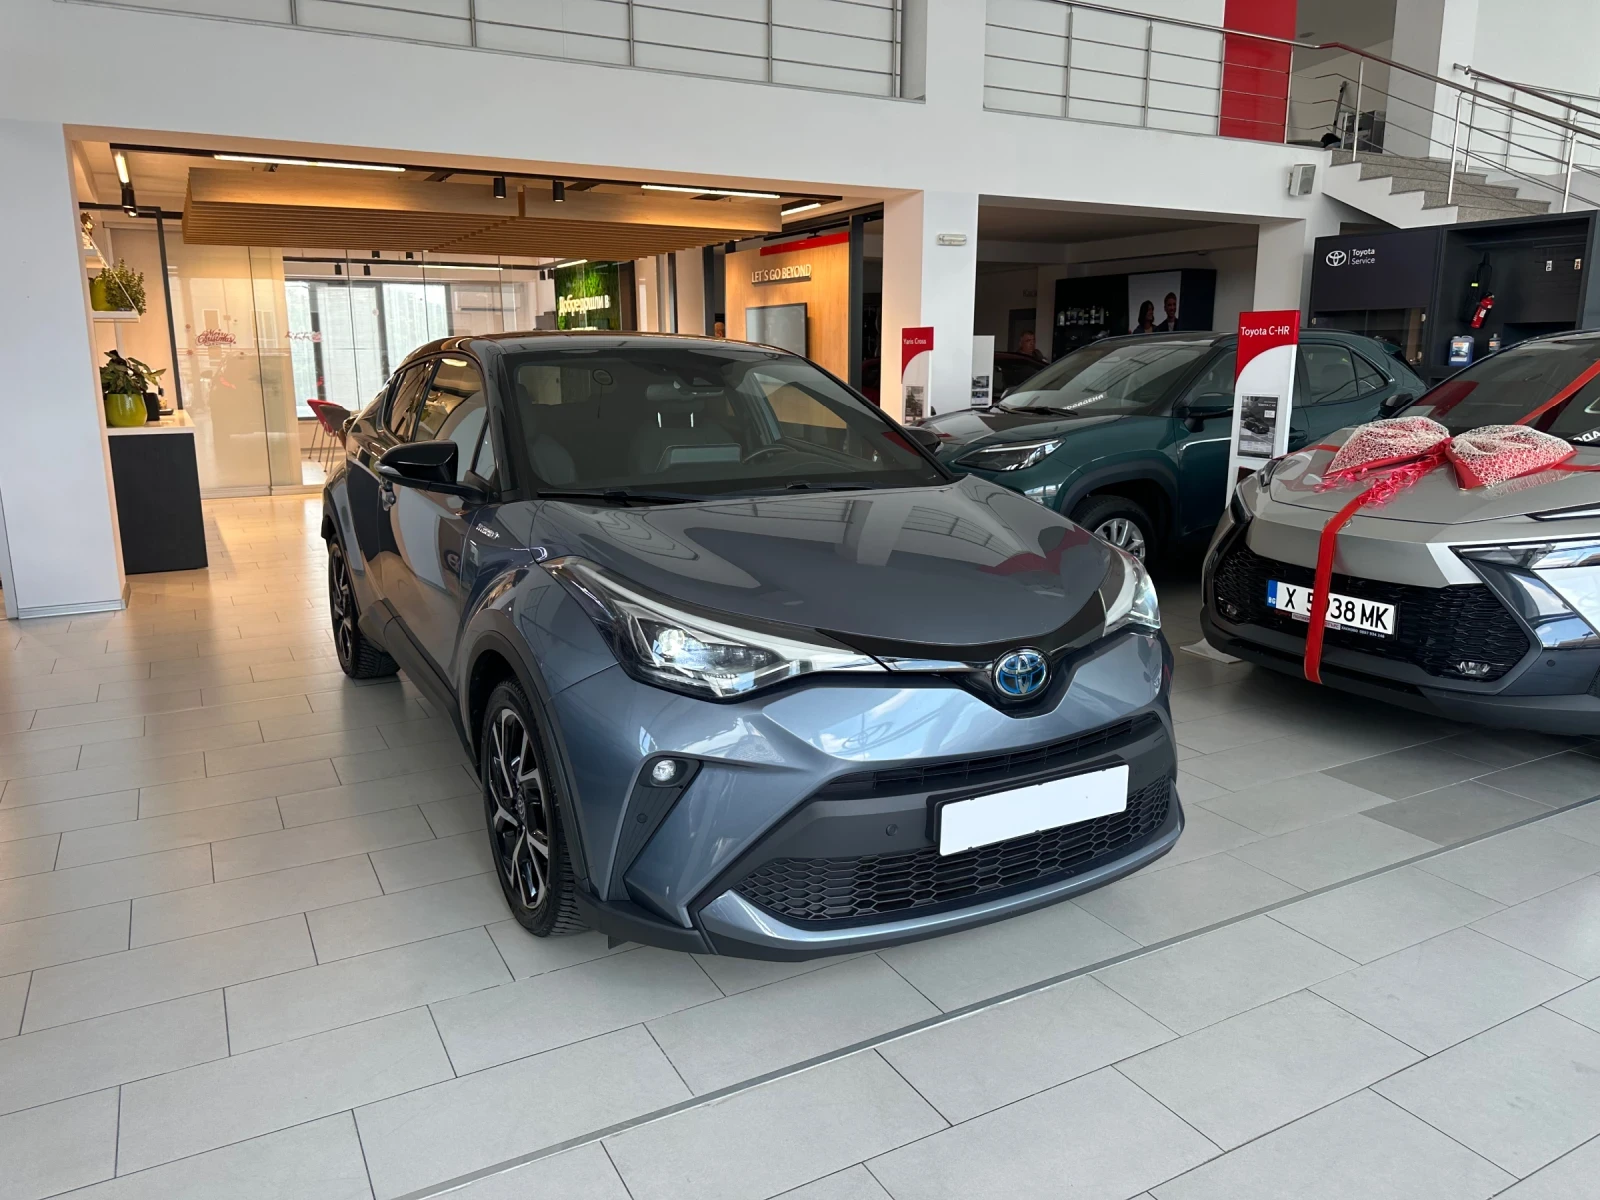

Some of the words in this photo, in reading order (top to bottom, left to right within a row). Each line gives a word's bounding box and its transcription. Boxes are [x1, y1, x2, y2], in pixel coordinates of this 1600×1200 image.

[1351, 248, 1376, 257] Toyota
[1351, 257, 1376, 265] Service
[770, 268, 781, 281] GO
[782, 264, 812, 279] BEYOND
[558, 294, 604, 316] Добредошли
[1240, 326, 1267, 338] Toyota
[1268, 325, 1290, 336] C-HR
[1284, 586, 1297, 610] X
[1360, 603, 1389, 631] MK
